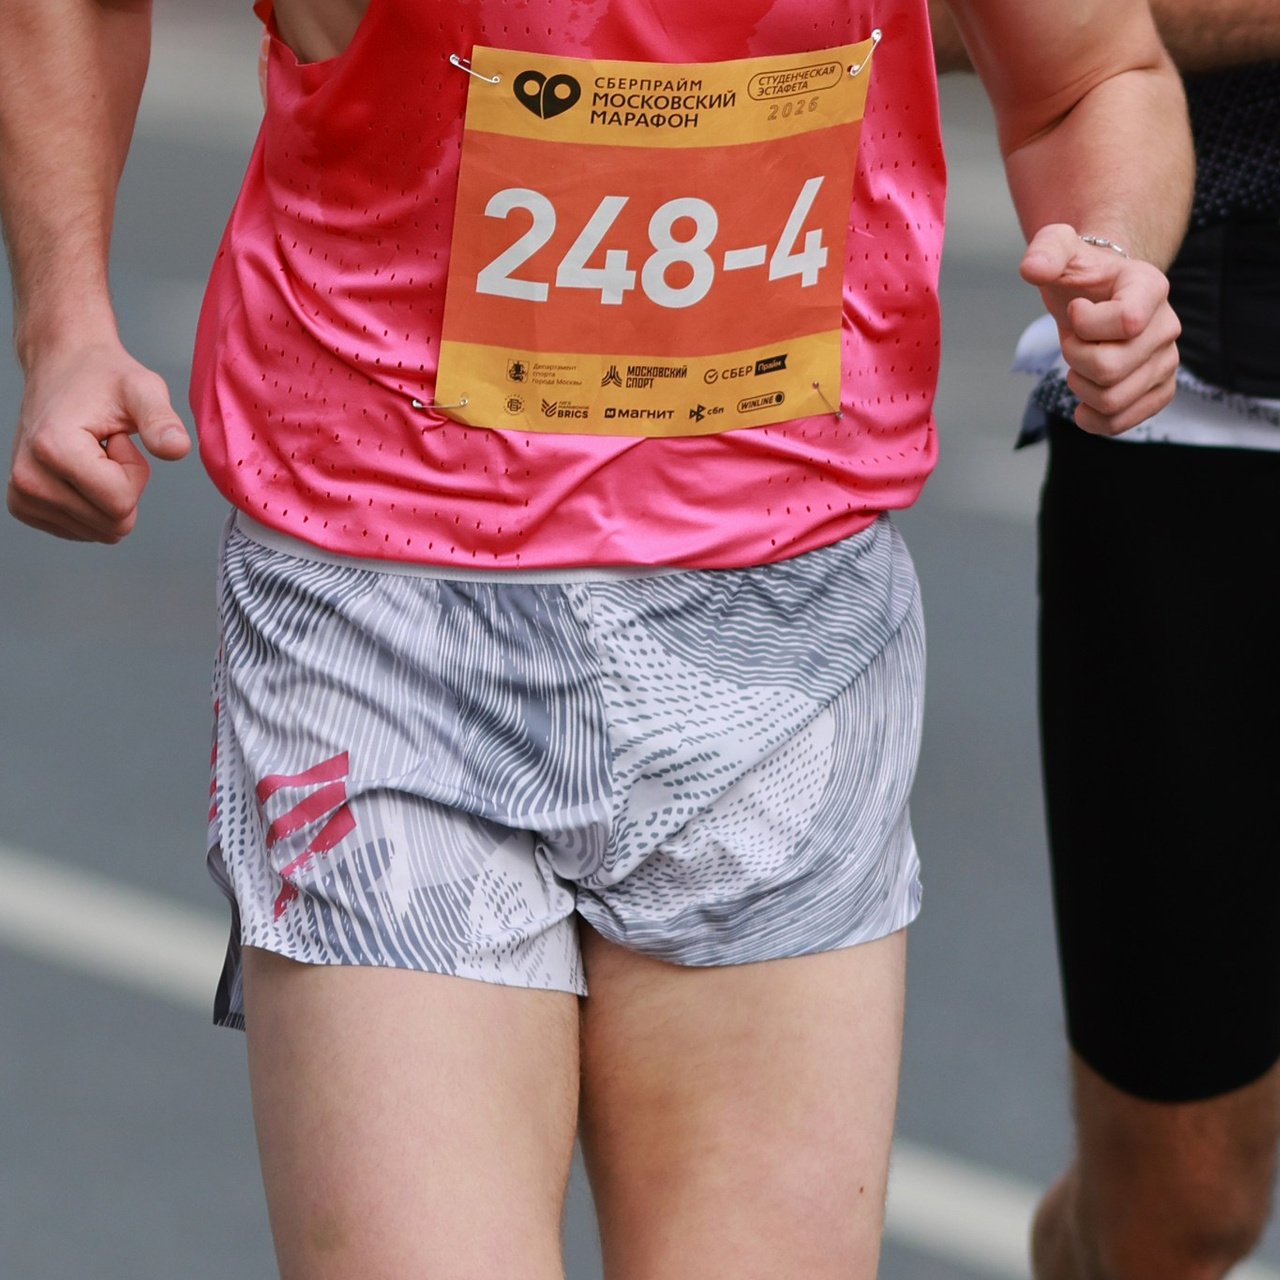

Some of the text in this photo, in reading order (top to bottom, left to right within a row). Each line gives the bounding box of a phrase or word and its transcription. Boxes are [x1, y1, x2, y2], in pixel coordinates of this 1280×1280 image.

[758, 65, 836, 86] СТУДЕНЧЕСКАЯ
[594, 76, 702, 92] СБЕРПРАЙМ
[757, 81, 809, 97] ЭСТАФЕТА
[592, 89, 736, 110] МОСКОВСКИЙ
[767, 96, 820, 121] 2026
[590, 110, 699, 128] МАРАФОН
[475, 175, 828, 309] 248-4
[626, 365, 688, 379] МОСКОВСКИЙ
[721, 365, 754, 380] СБЕР
[625, 378, 654, 389] СПОРТ
[740, 395, 774, 411] WINLINE
[557, 410, 589, 419] BRICS
